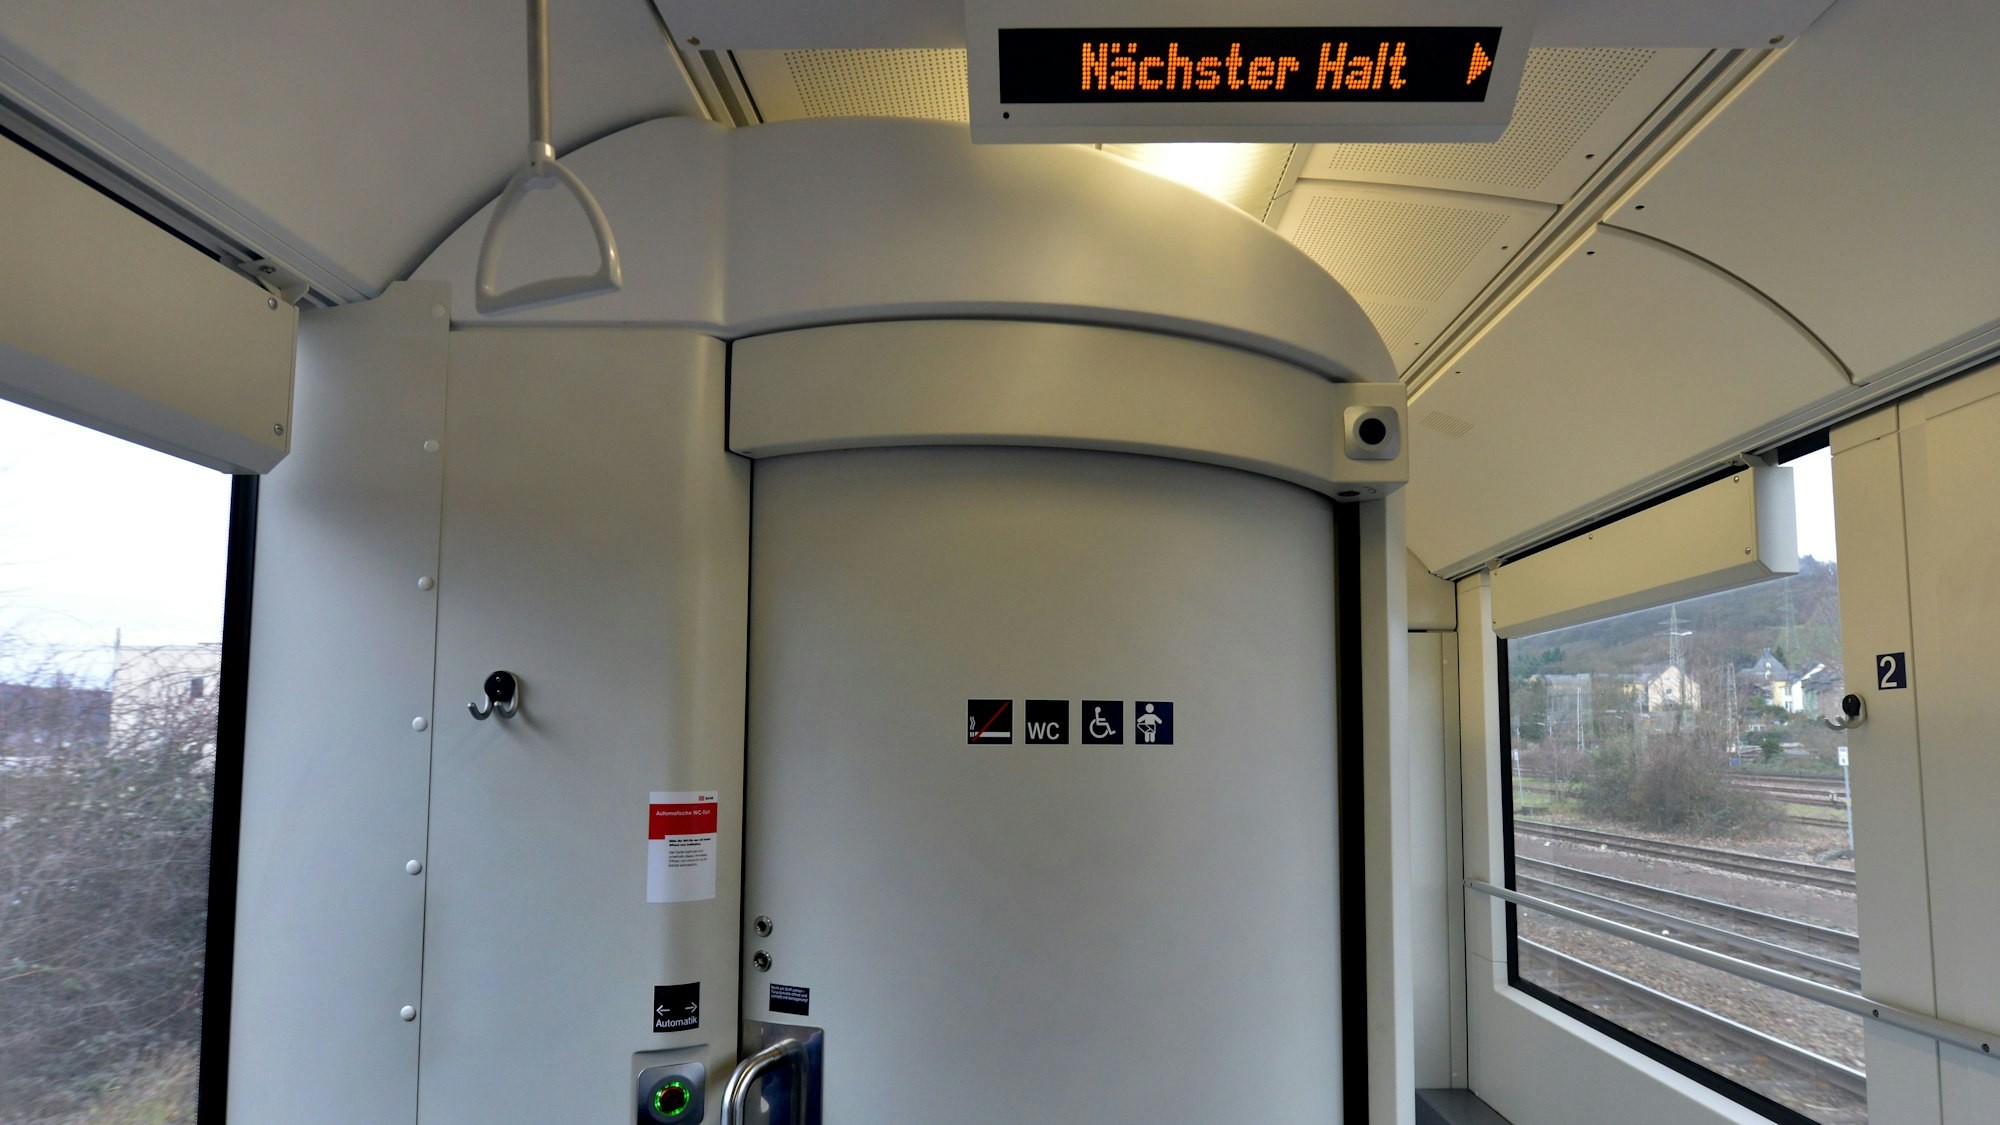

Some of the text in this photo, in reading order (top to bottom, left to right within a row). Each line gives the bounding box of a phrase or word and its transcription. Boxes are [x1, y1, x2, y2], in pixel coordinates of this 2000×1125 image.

[1081, 42, 1407, 90] Nächster Halt
[1880, 655, 1898, 689] 2
[1027, 722, 1059, 740] WC
[655, 1016, 697, 1027] Automatik
